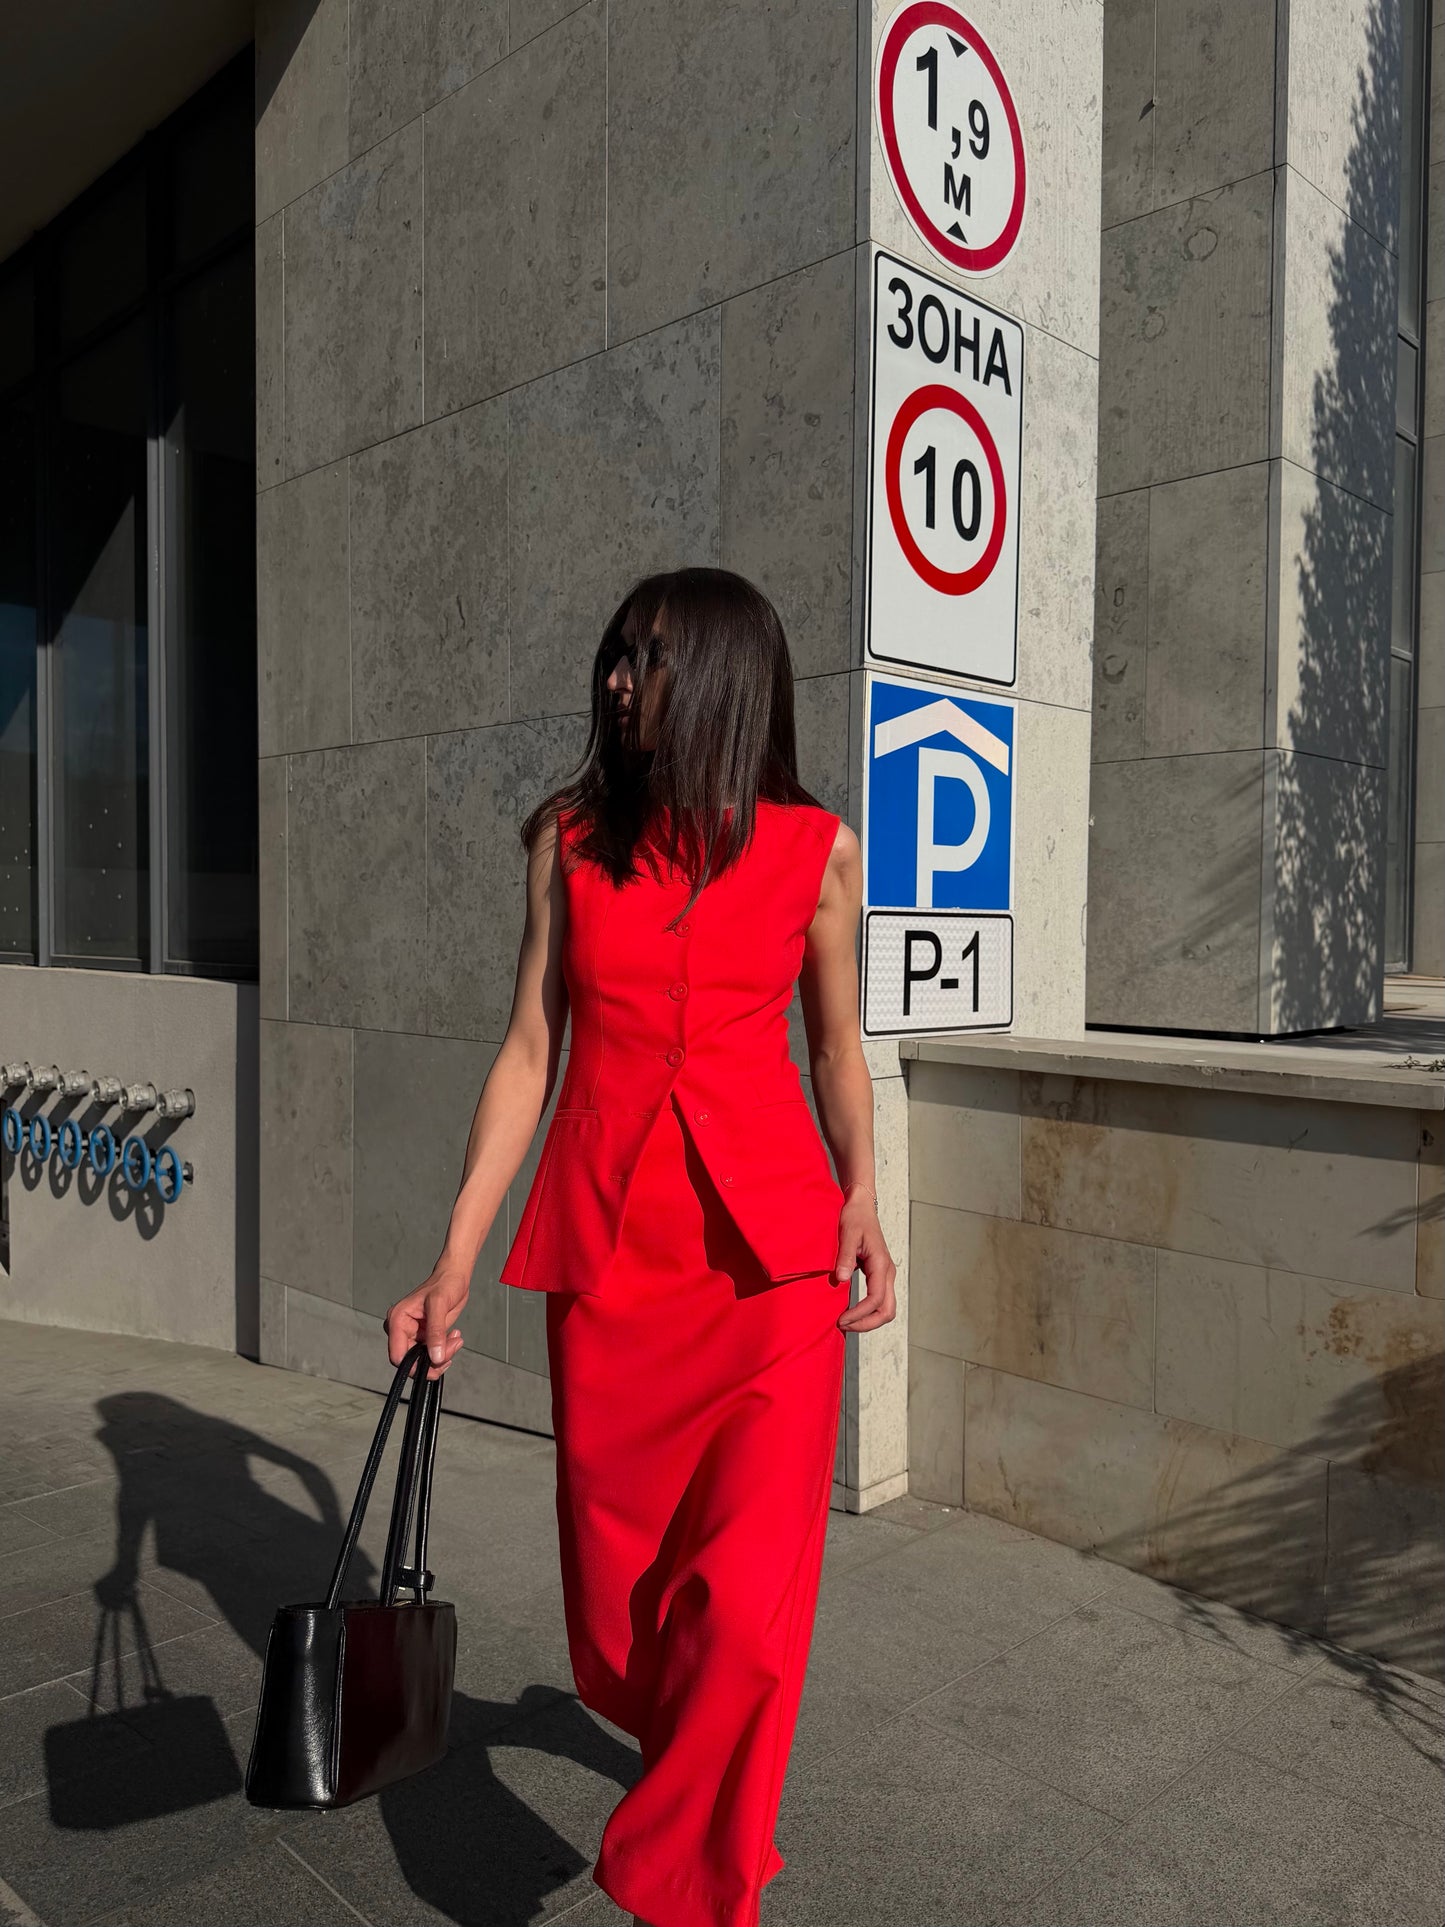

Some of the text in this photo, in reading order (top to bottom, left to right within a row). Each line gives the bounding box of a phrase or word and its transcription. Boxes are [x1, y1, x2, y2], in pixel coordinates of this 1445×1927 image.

[916, 46, 990, 161] 1,9
[887, 277, 1012, 397] ЗОНА
[914, 445, 981, 541] 10
[916, 747, 991, 908] P
[903, 930, 979, 1016] P-1
